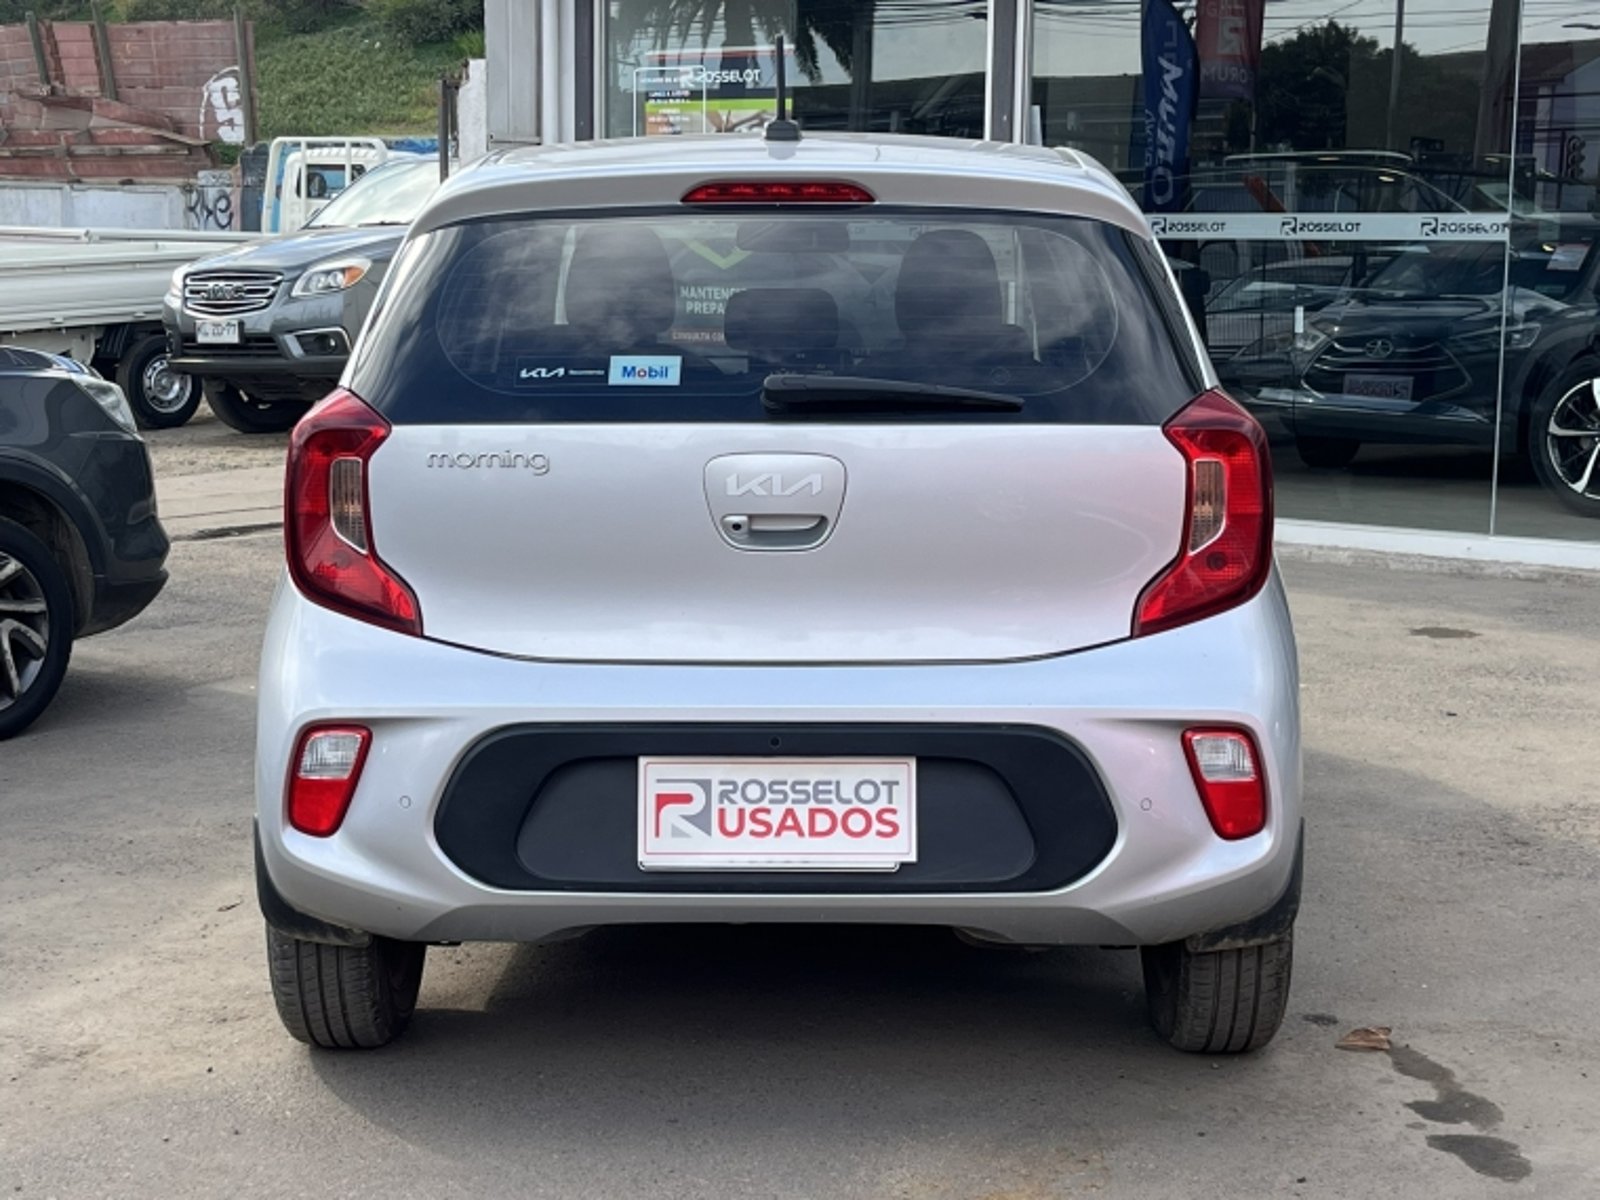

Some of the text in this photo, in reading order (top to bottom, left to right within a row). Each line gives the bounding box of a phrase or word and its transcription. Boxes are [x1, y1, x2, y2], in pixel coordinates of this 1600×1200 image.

[1168, 222, 1226, 232] ROSSELOT
[1299, 222, 1361, 232] ROSSELOT
[1440, 222, 1509, 233] ROSSELOT
[686, 300, 725, 314] PREPA
[621, 366, 668, 379] Mobil
[426, 449, 550, 477] morning
[726, 473, 822, 496] KIA
[718, 779, 899, 804] ROSSELOT
[718, 808, 900, 838] USADOS
